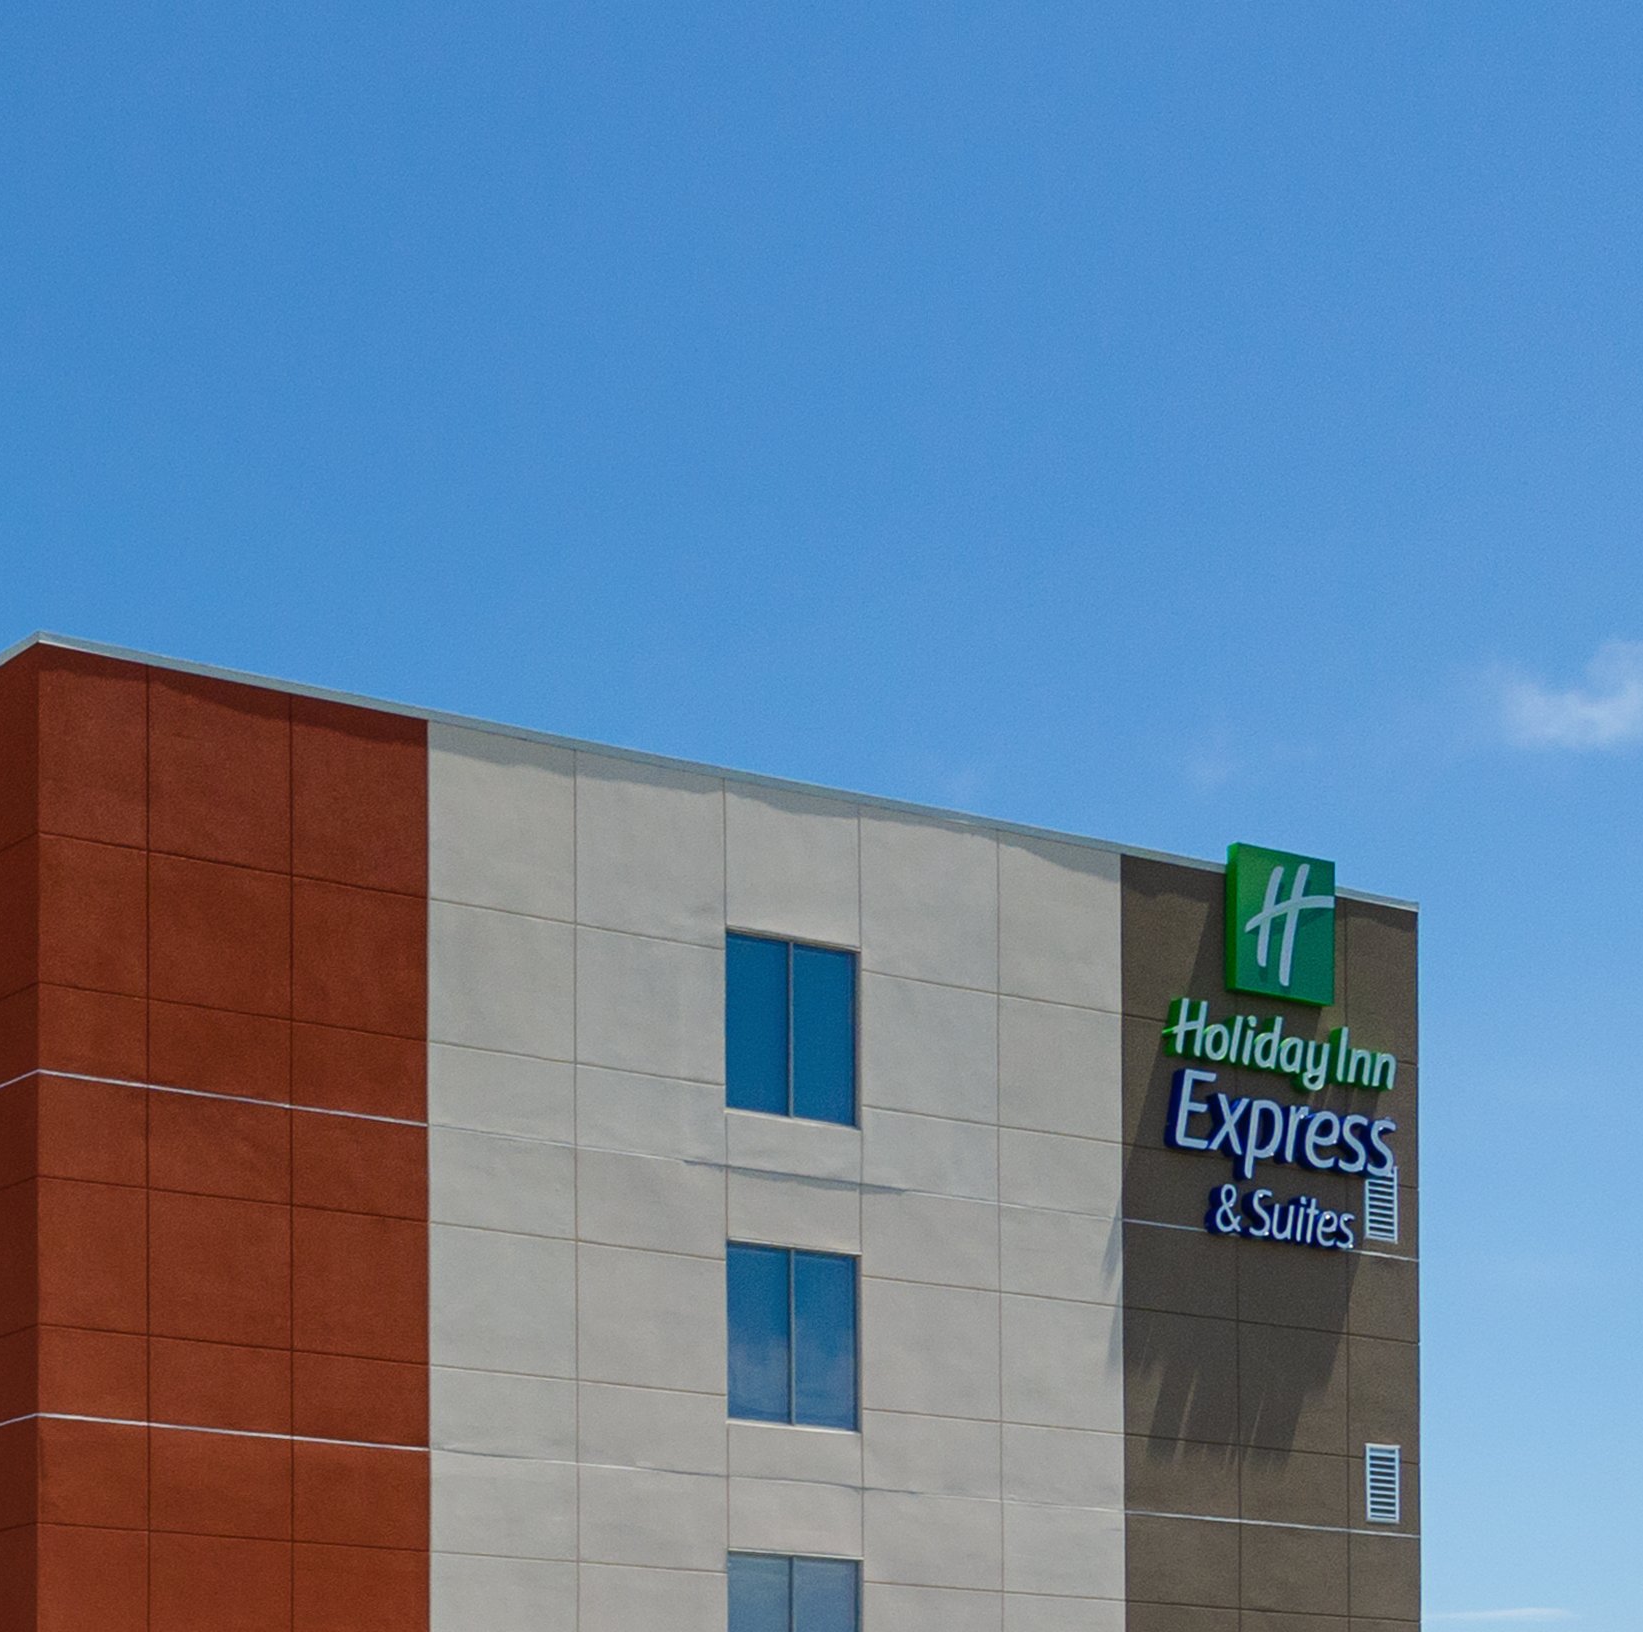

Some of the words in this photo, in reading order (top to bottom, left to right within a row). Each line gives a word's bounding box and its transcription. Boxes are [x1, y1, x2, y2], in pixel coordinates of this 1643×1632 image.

[1164, 997, 1330, 1092] Holiday
[1334, 1027, 1397, 1090] Inn
[1174, 1068, 1397, 1180] Express
[1214, 1183, 1242, 1233] &
[1248, 1189, 1356, 1250] Suites
